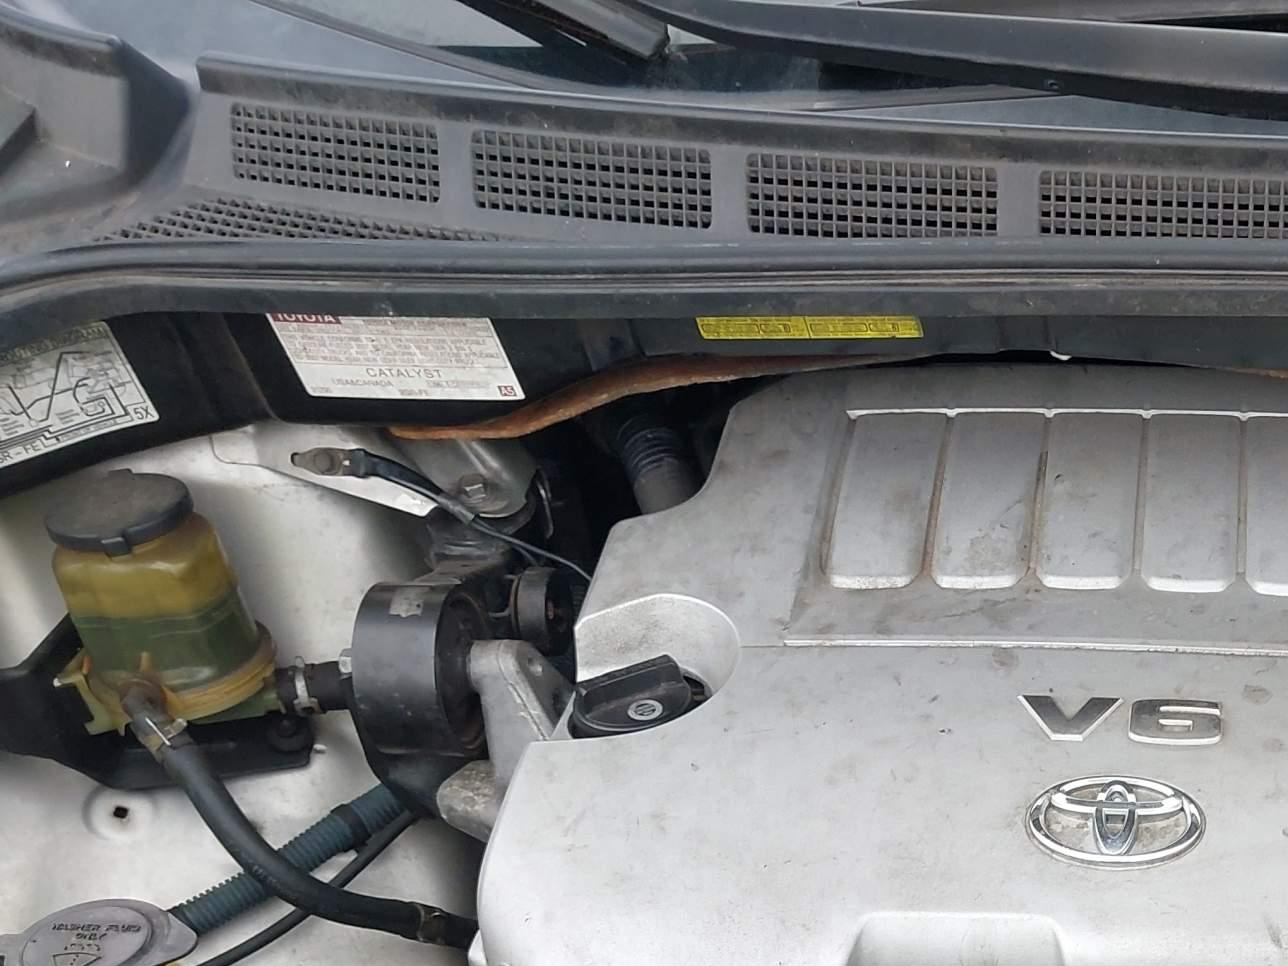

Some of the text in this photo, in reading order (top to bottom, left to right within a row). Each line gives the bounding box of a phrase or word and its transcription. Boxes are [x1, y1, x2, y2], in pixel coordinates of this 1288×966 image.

[366, 367, 442, 379] CATALYST
[133, 406, 155, 421] 5X
[1017, 694, 1223, 746] V6
